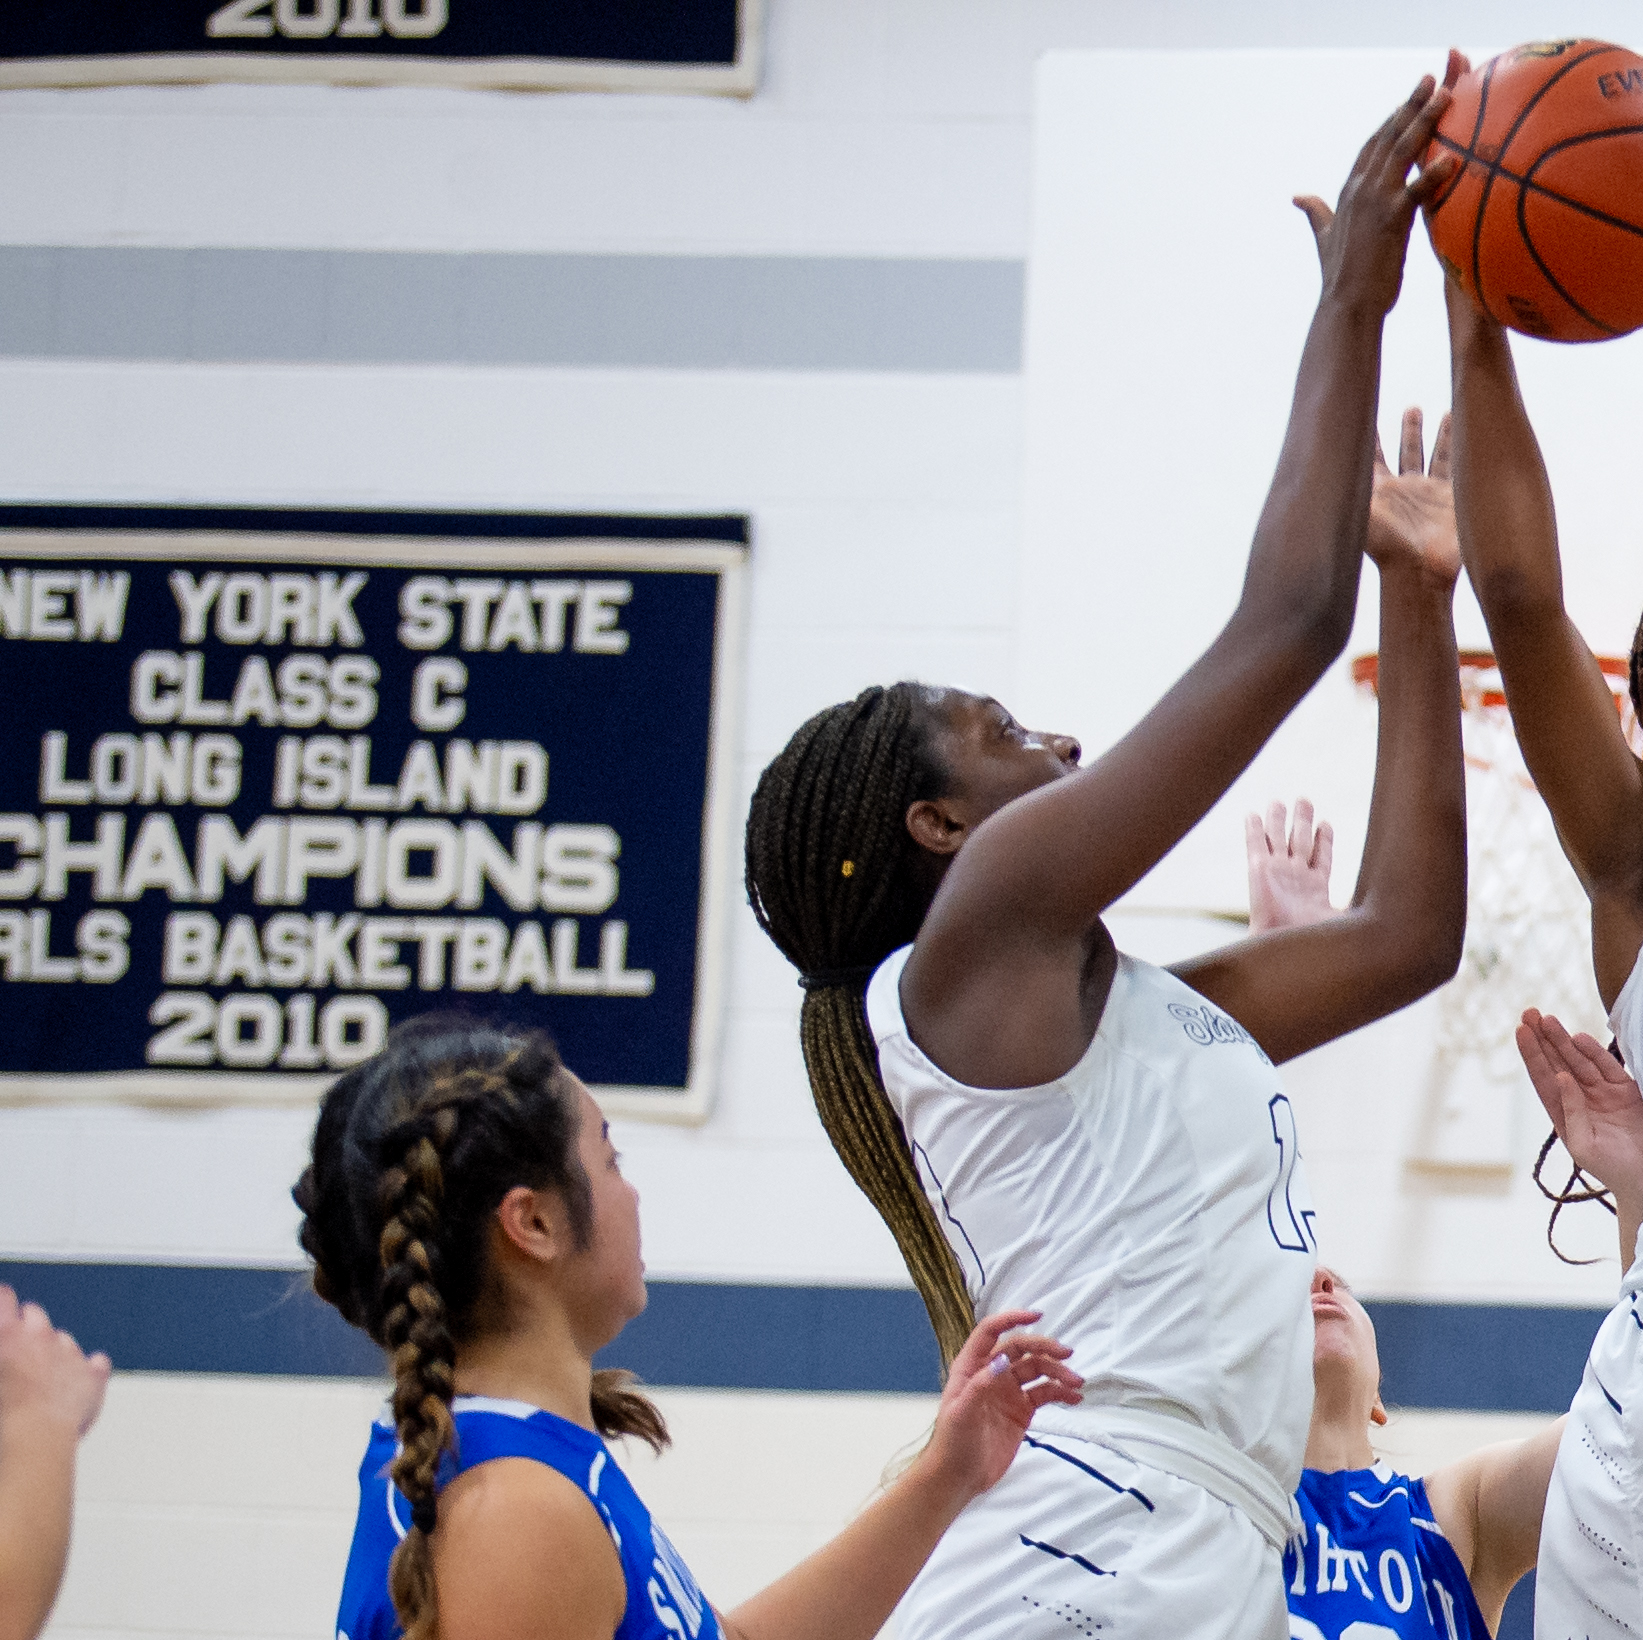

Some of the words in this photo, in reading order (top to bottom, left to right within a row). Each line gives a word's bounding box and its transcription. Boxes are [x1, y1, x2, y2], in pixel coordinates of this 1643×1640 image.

[0, 569, 130, 642] NEW
[168, 571, 367, 647] YORK
[399, 576, 633, 654] STATE
[131, 650, 381, 728] CLASS
[411, 656, 468, 732] C
[40, 730, 243, 806] LONG
[273, 734, 550, 816] ISLAND
[162, 911, 655, 996] BASKETBALL
[146, 990, 388, 1069] 2010
